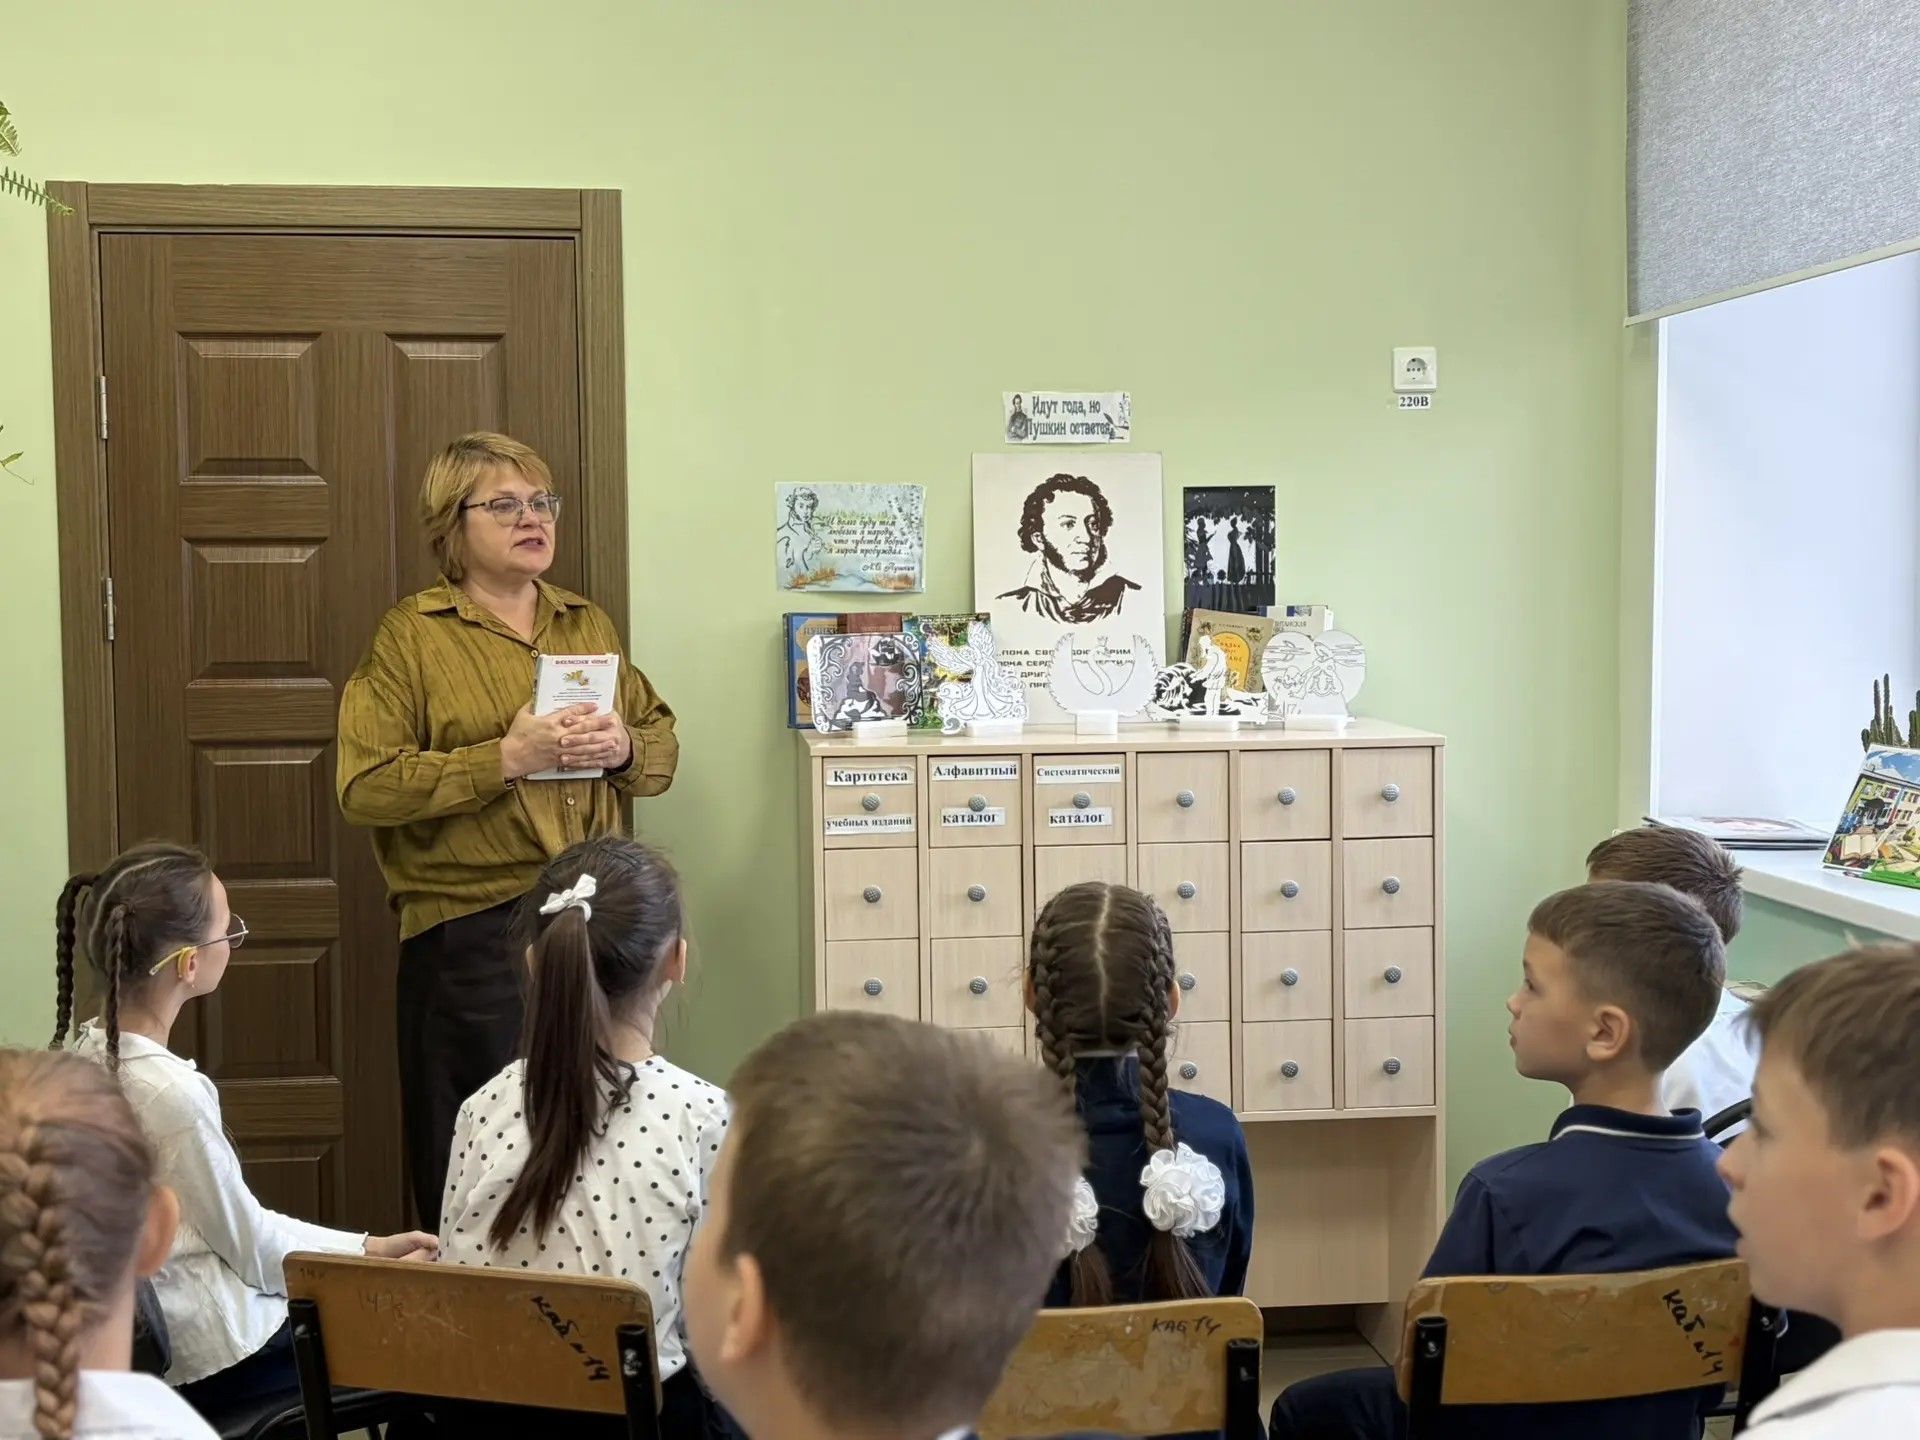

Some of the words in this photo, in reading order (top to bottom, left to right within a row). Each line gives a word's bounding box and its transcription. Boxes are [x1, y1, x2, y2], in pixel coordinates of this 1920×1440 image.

[1031, 395, 1058, 419] Идут
[1062, 400, 1087, 417] года,
[1089, 400, 1101, 413] но
[1399, 396, 1429, 407] 220В
[1026, 418, 1067, 441] Пушкин
[833, 770, 909, 785] Картотека
[933, 764, 1018, 780] Алфавитный
[1037, 766, 1120, 777] Систематический
[826, 818, 869, 830] учебных
[871, 816, 913, 827] изданий
[942, 812, 998, 824] каталог
[1049, 813, 1105, 825] каталог
